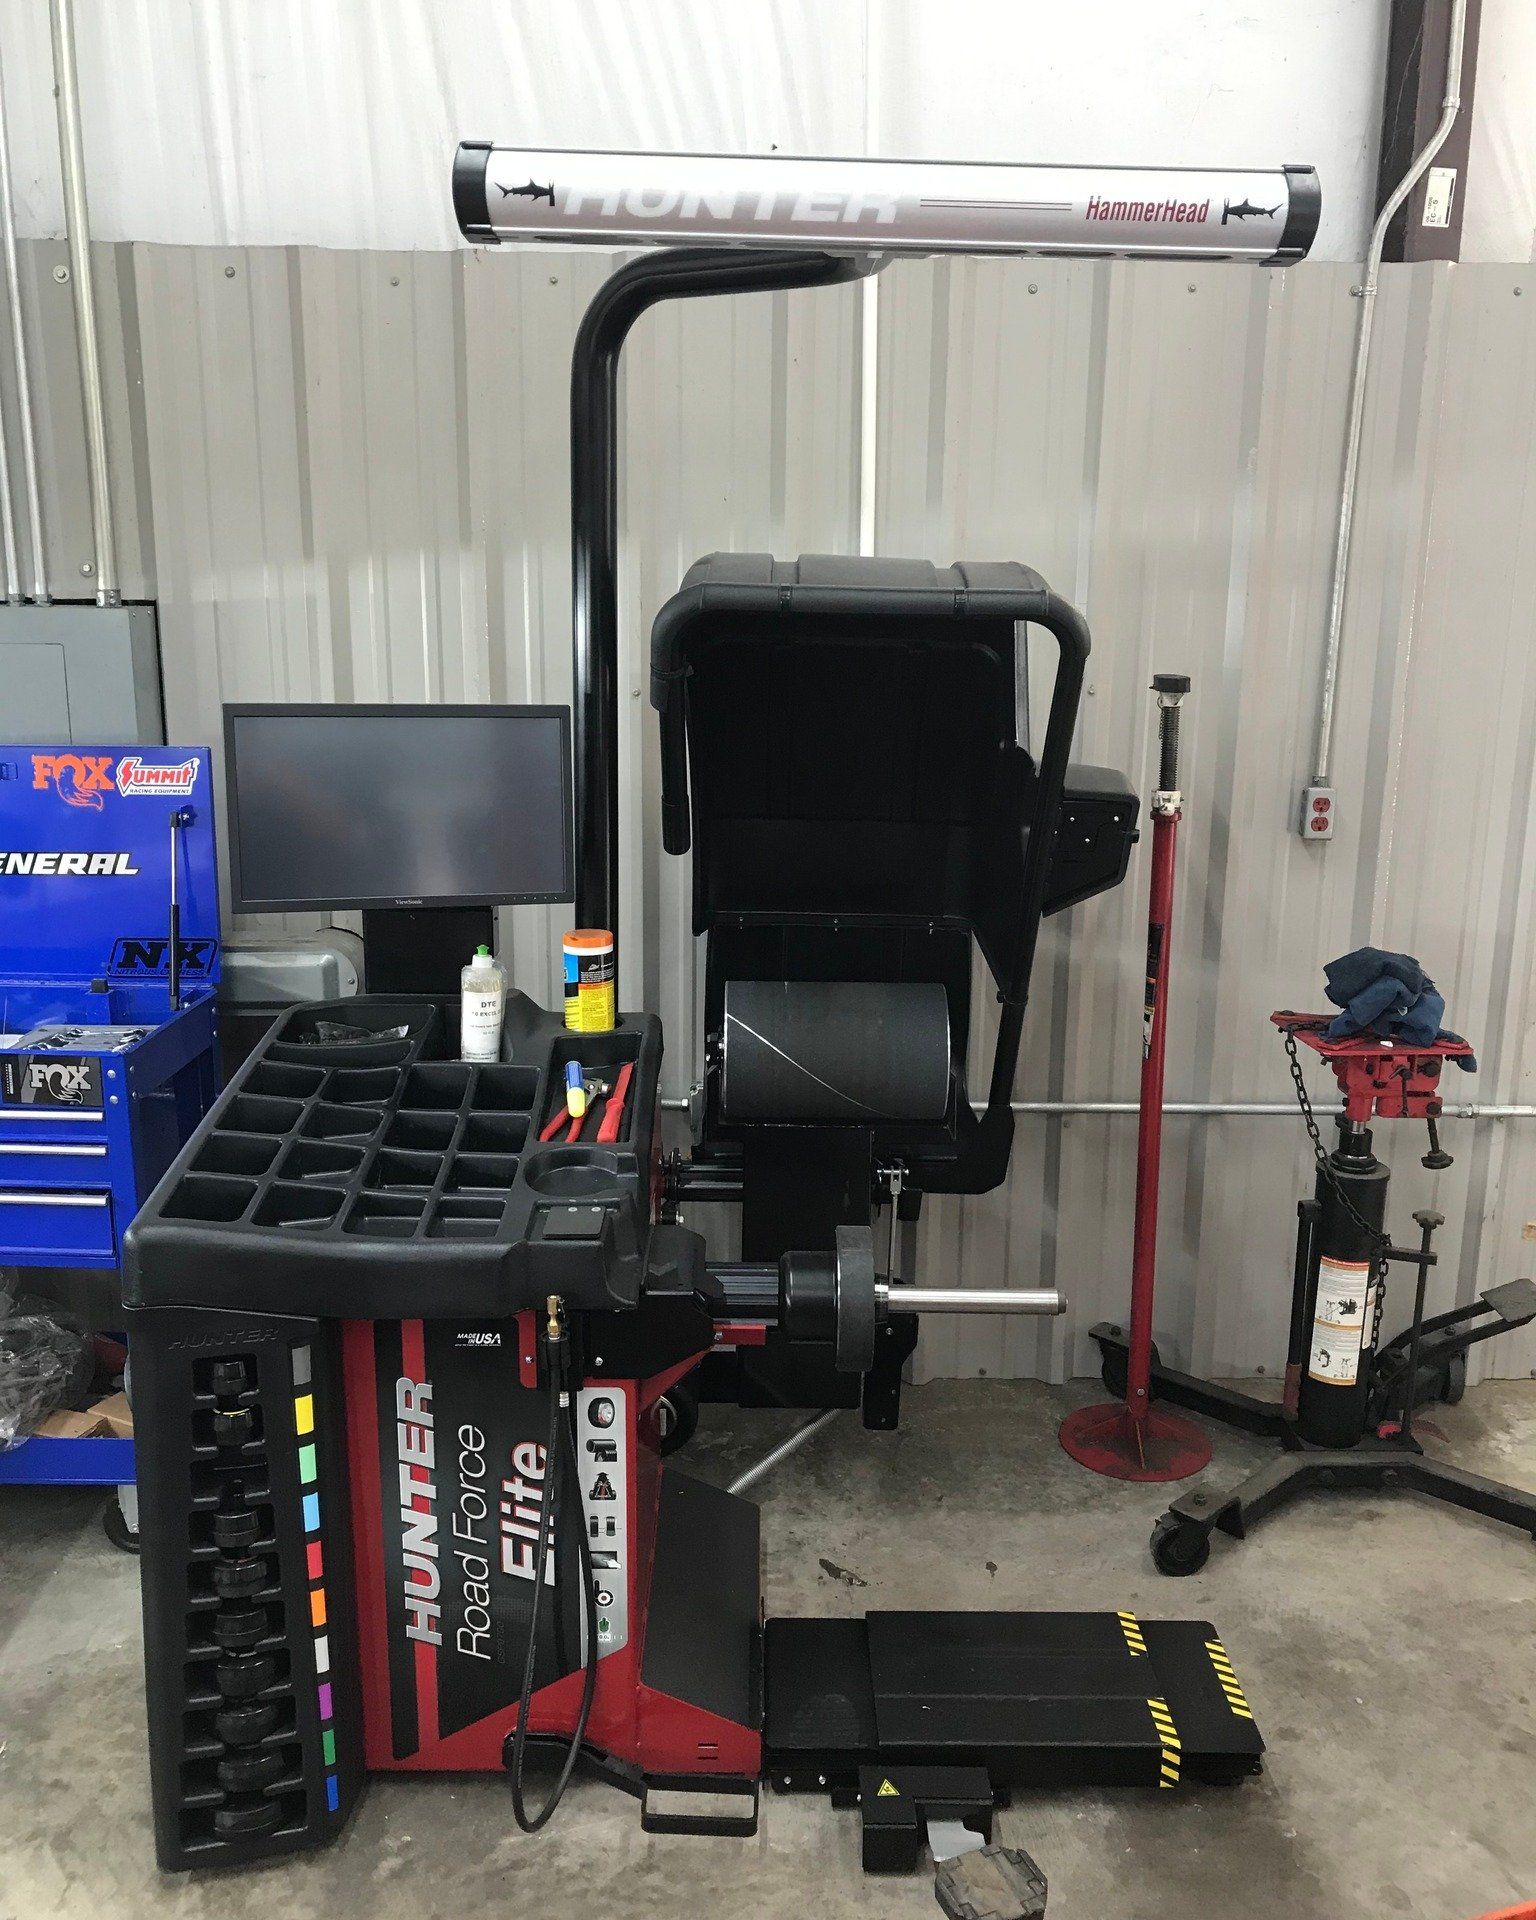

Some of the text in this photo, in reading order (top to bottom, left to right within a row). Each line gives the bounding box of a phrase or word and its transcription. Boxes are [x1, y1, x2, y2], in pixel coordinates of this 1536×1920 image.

[562, 184, 899, 224] HUNTER
[1085, 195, 1211, 223] HammerHead
[32, 754, 115, 803] FOX
[116, 942, 211, 969] NX
[29, 1064, 92, 1099] FOX
[167, 1328, 280, 1350] HUNTER
[475, 1333, 502, 1345] USA
[395, 1377, 443, 1646] HUNTER
[500, 1440, 556, 1587] Elite
[452, 1424, 491, 1660] Road Force
